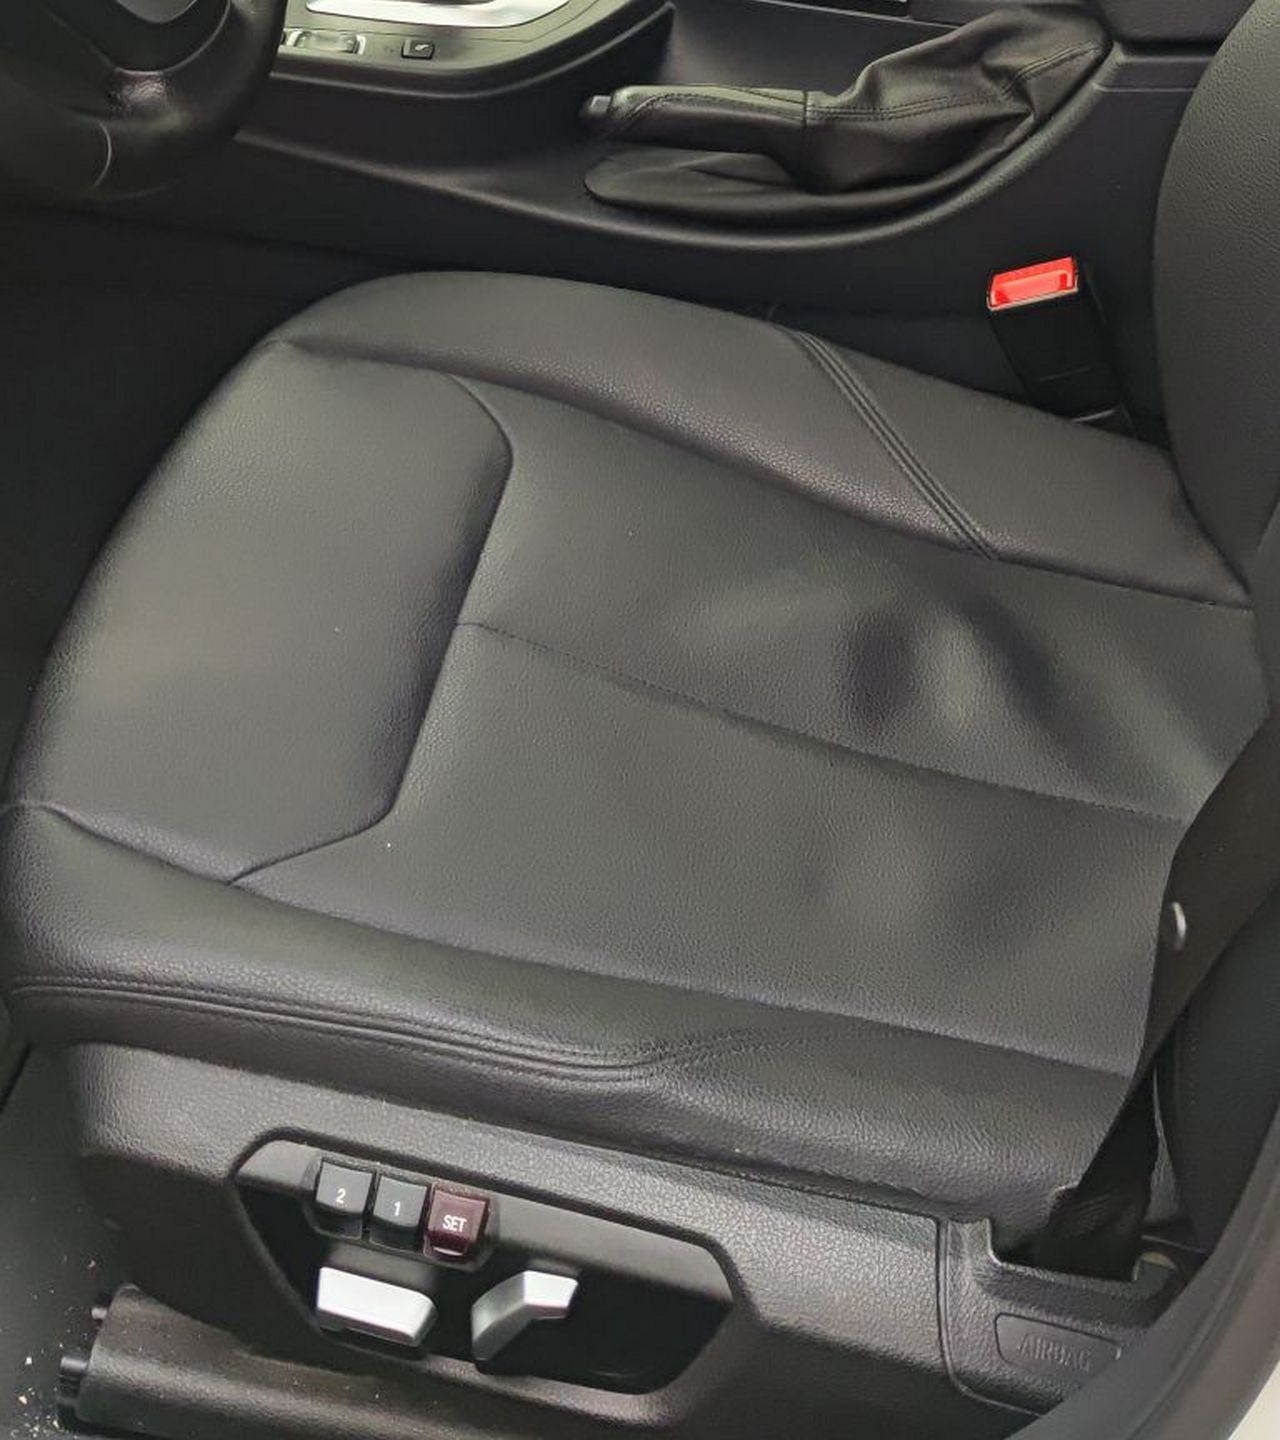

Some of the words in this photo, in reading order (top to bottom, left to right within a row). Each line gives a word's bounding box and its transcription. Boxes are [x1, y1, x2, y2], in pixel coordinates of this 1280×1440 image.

[335, 1188, 347, 1205] 2
[394, 1201, 402, 1217] 1
[442, 1214, 468, 1232] SET
